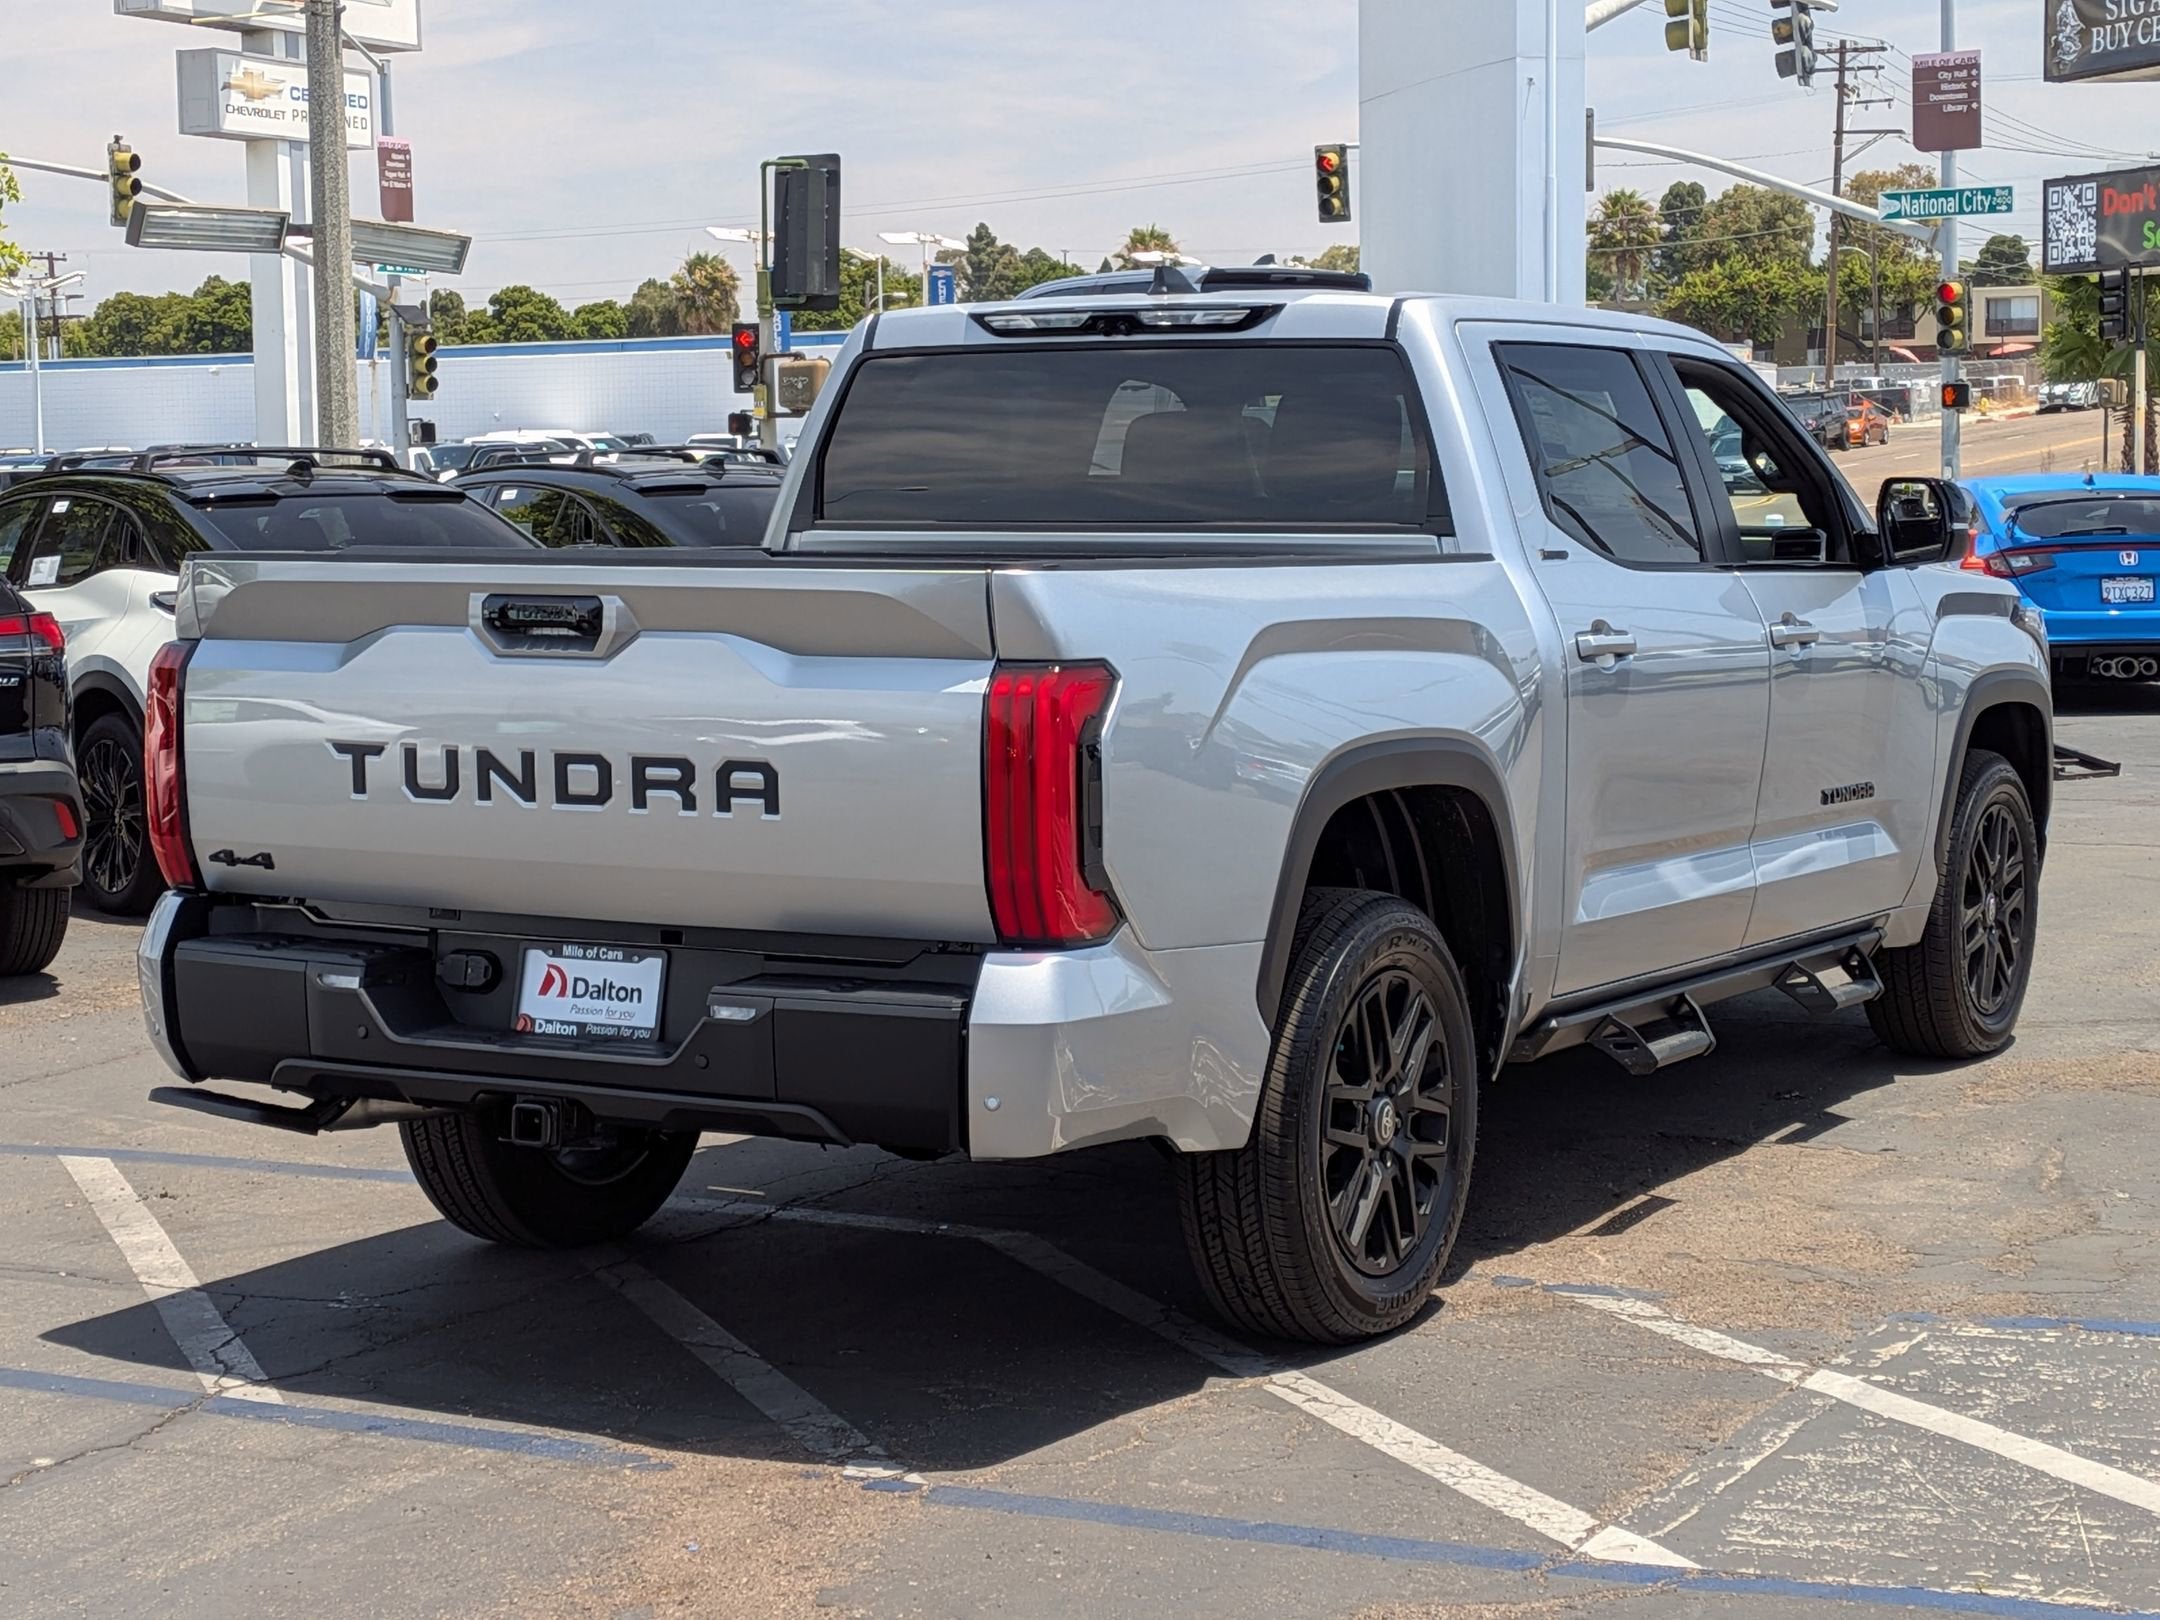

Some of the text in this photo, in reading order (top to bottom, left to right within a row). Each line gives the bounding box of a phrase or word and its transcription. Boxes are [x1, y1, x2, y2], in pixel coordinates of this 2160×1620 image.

[2090, 20, 2134, 54] BUY
[225, 104, 287, 121] CHEVROLET
[1943, 104, 1968, 113] Library
[1901, 192, 1959, 216] National
[1962, 190, 1991, 213] City
[2103, 183, 2157, 216] Don't
[325, 738, 782, 821] TUNDRA
[1820, 781, 1876, 806] TUNDRA
[562, 944, 623, 961] Mile of Cars
[571, 976, 642, 1004] Dalton
[569, 1003, 636, 1020] Passion for you
[534, 1019, 651, 1040] Dalton Passion for you
